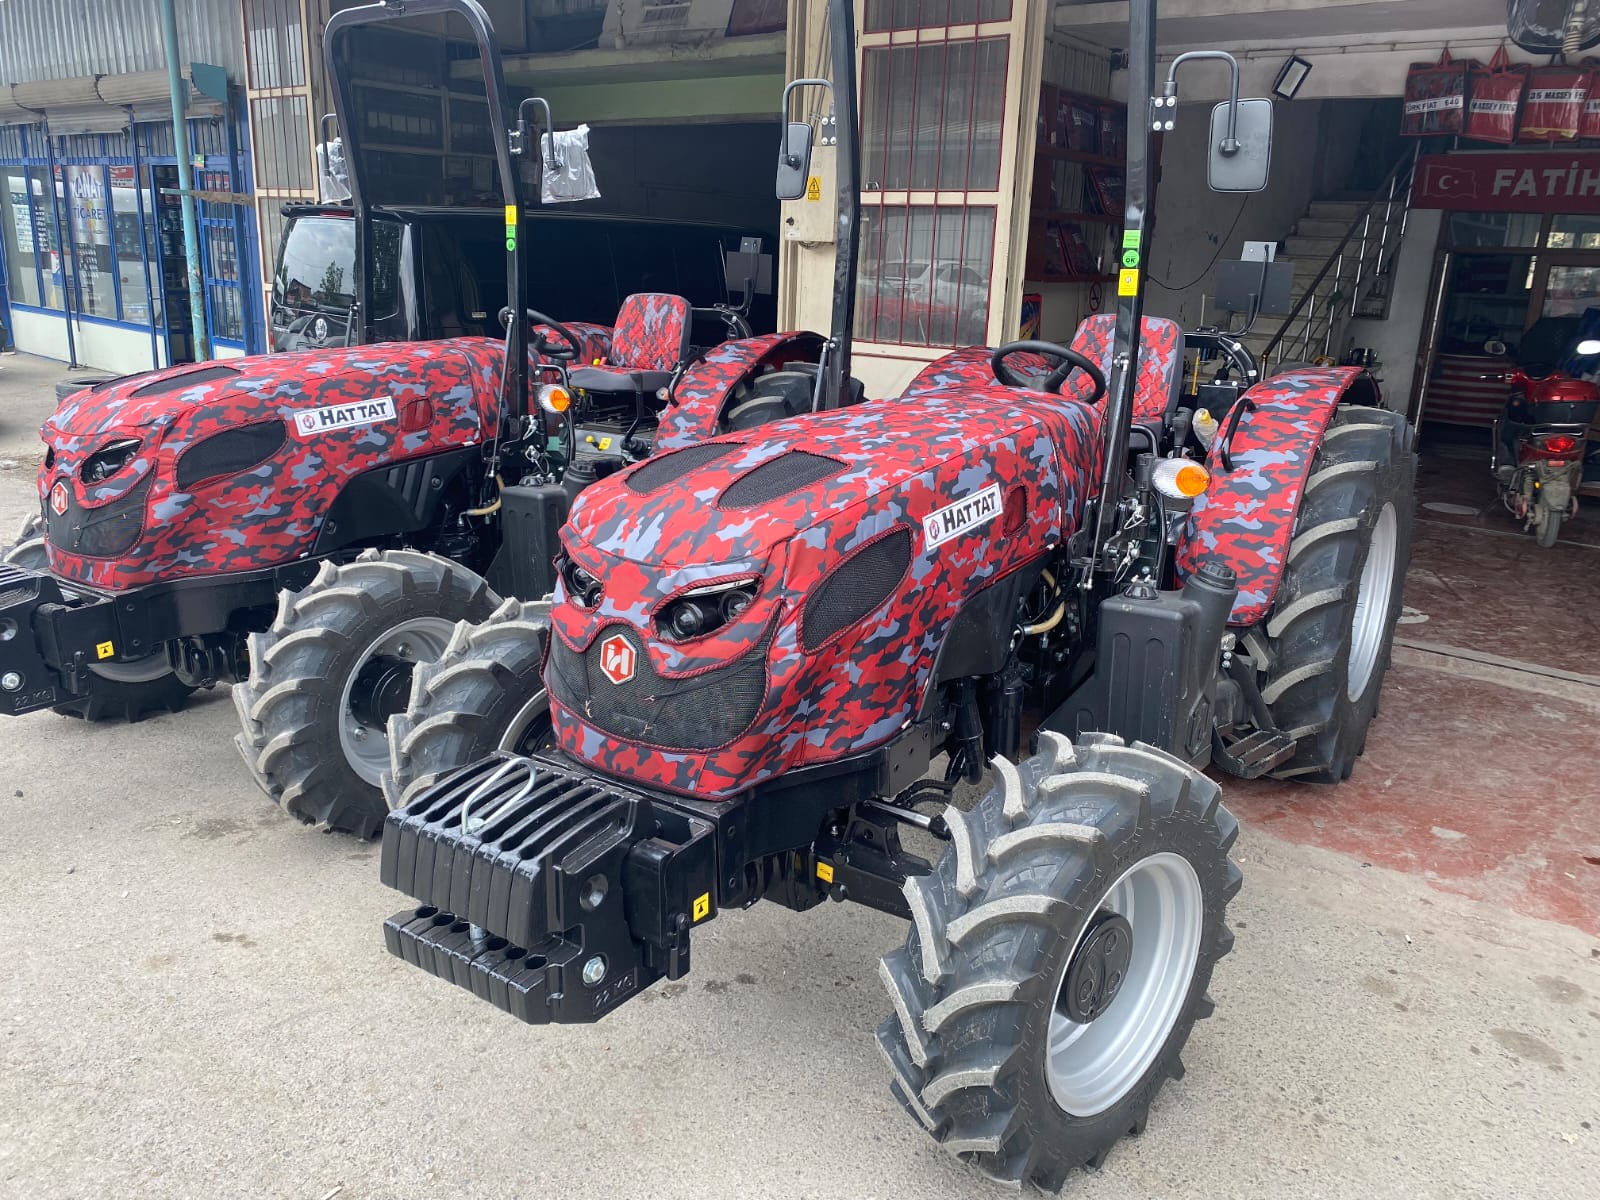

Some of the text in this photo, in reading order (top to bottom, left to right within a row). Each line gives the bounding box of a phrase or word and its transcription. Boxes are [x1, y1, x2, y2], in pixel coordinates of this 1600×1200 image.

[1444, 98, 1459, 106] 640
[71, 171, 102, 199] KANAT
[1491, 161, 1600, 197] FATİH
[319, 402, 387, 426] HATTAT
[942, 492, 996, 533] HATTAT
